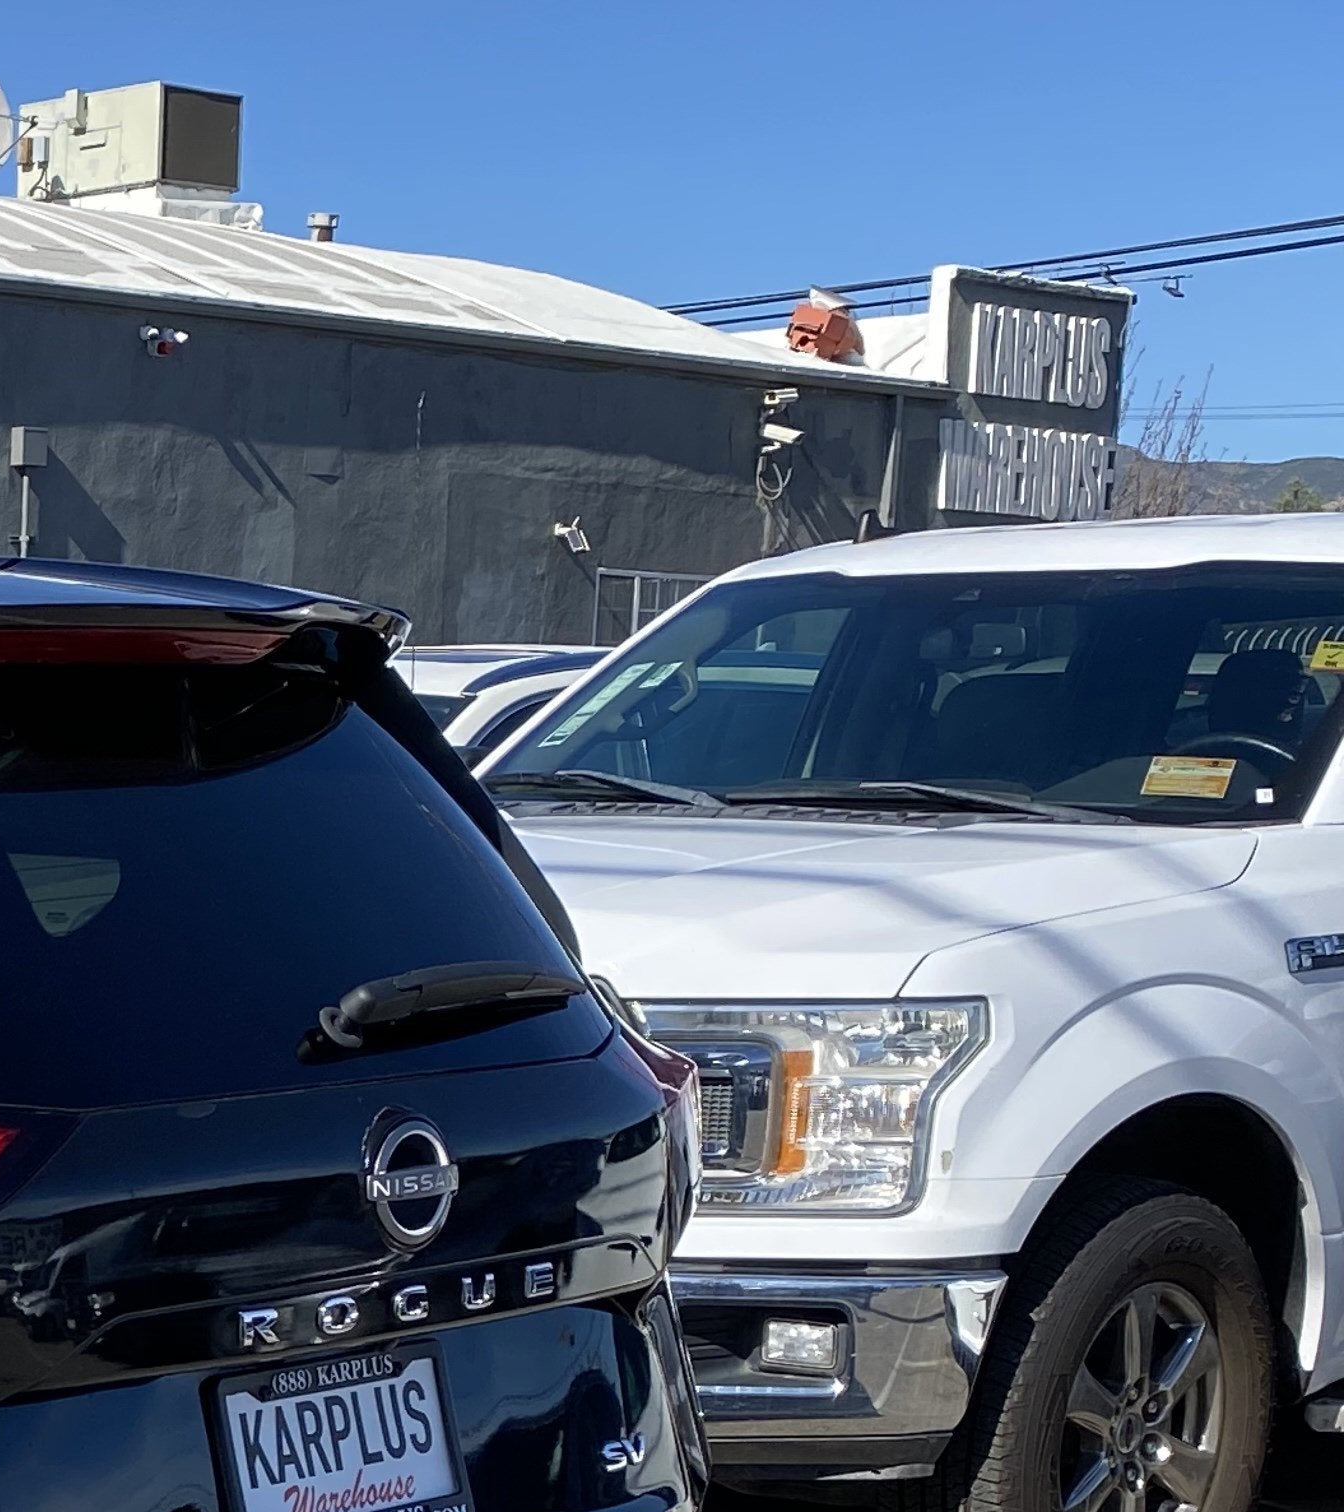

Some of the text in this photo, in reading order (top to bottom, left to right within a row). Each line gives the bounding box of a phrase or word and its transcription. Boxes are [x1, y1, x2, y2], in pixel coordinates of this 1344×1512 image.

[967, 301, 1111, 410] KARPLUS
[937, 417, 1116, 522] WAREHOUSE
[238, 1261, 556, 1347] ROGUE
[272, 1353, 394, 1396] (888) KARPLUS
[238, 1379, 433, 1490] KARPLUS
[601, 1434, 646, 1472] SV
